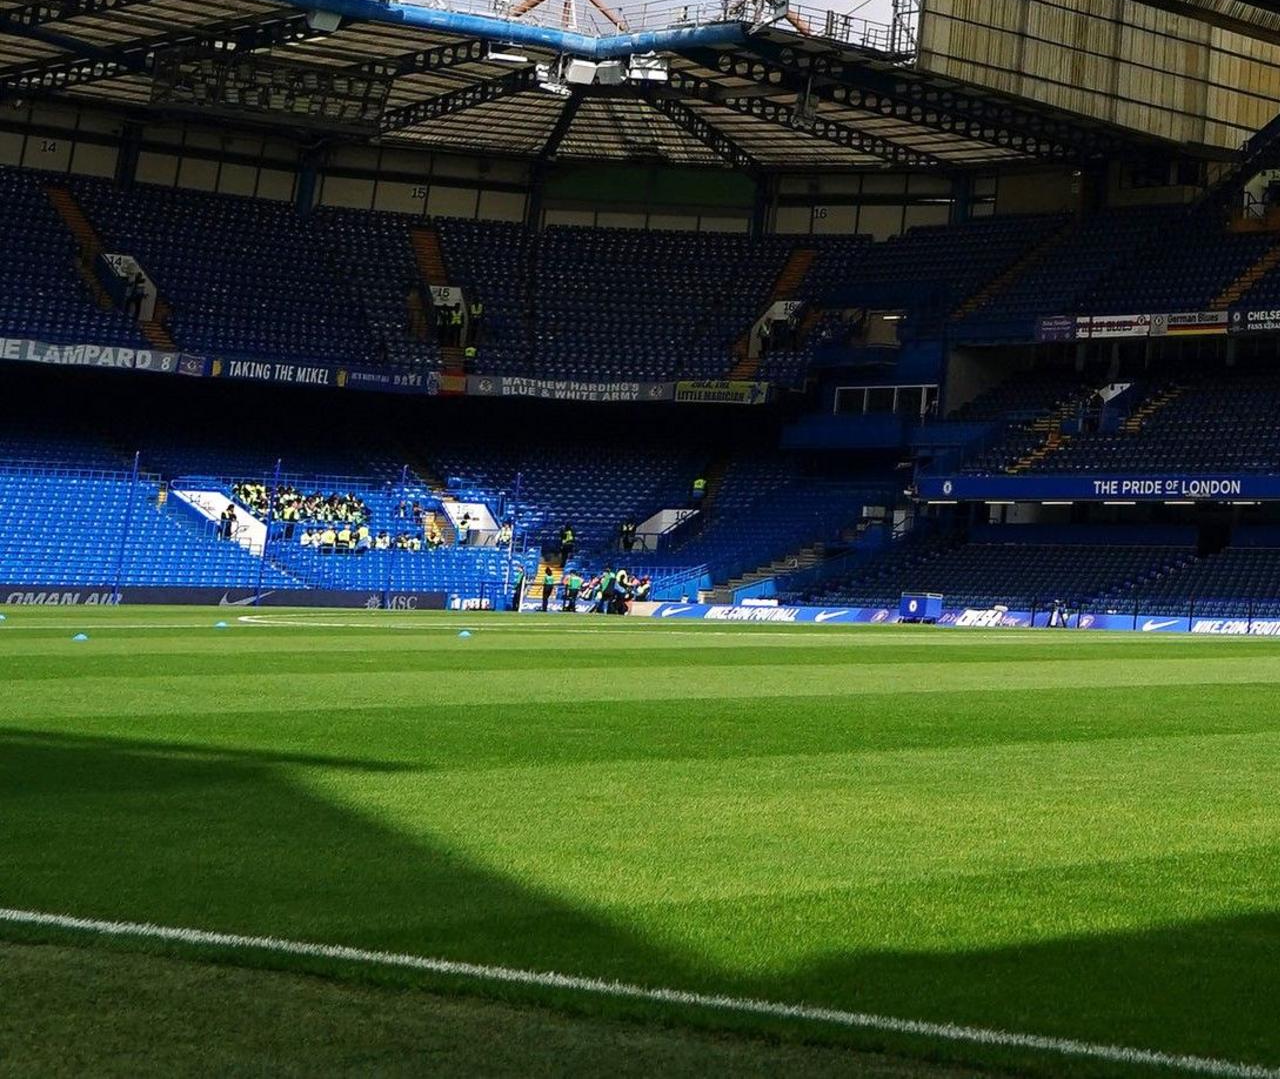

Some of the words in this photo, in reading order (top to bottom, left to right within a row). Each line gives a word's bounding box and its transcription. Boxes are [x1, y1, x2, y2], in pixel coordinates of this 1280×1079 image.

[41, 140, 56, 152] 14
[411, 186, 426, 199] 15
[815, 207, 828, 220] 16
[110, 256, 122, 267] 14
[437, 288, 449, 297] 15
[784, 302, 795, 311] 16
[1167, 314, 1196, 323] German
[27, 340, 152, 368] LAMPARD
[161, 356, 170, 369] 8
[229, 360, 271, 379] TAKING
[274, 363, 294, 381] THE
[295, 367, 329, 385] MIKEL
[502, 376, 567, 390] MATTHEW
[570, 381, 640, 392] HARDING'S
[502, 386, 538, 397] BLUE
[539, 387, 551, 398] &
[554, 389, 600, 400] WHITE
[602, 392, 640, 401] ARMY
[1093, 480, 1118, 495] THE
[1122, 480, 1163, 495] PRIDE
[1165, 480, 1179, 493] OF
[1181, 480, 1241, 495] LONDON
[5, 592, 80, 606] OMAN
[386, 596, 418, 610] MSC
